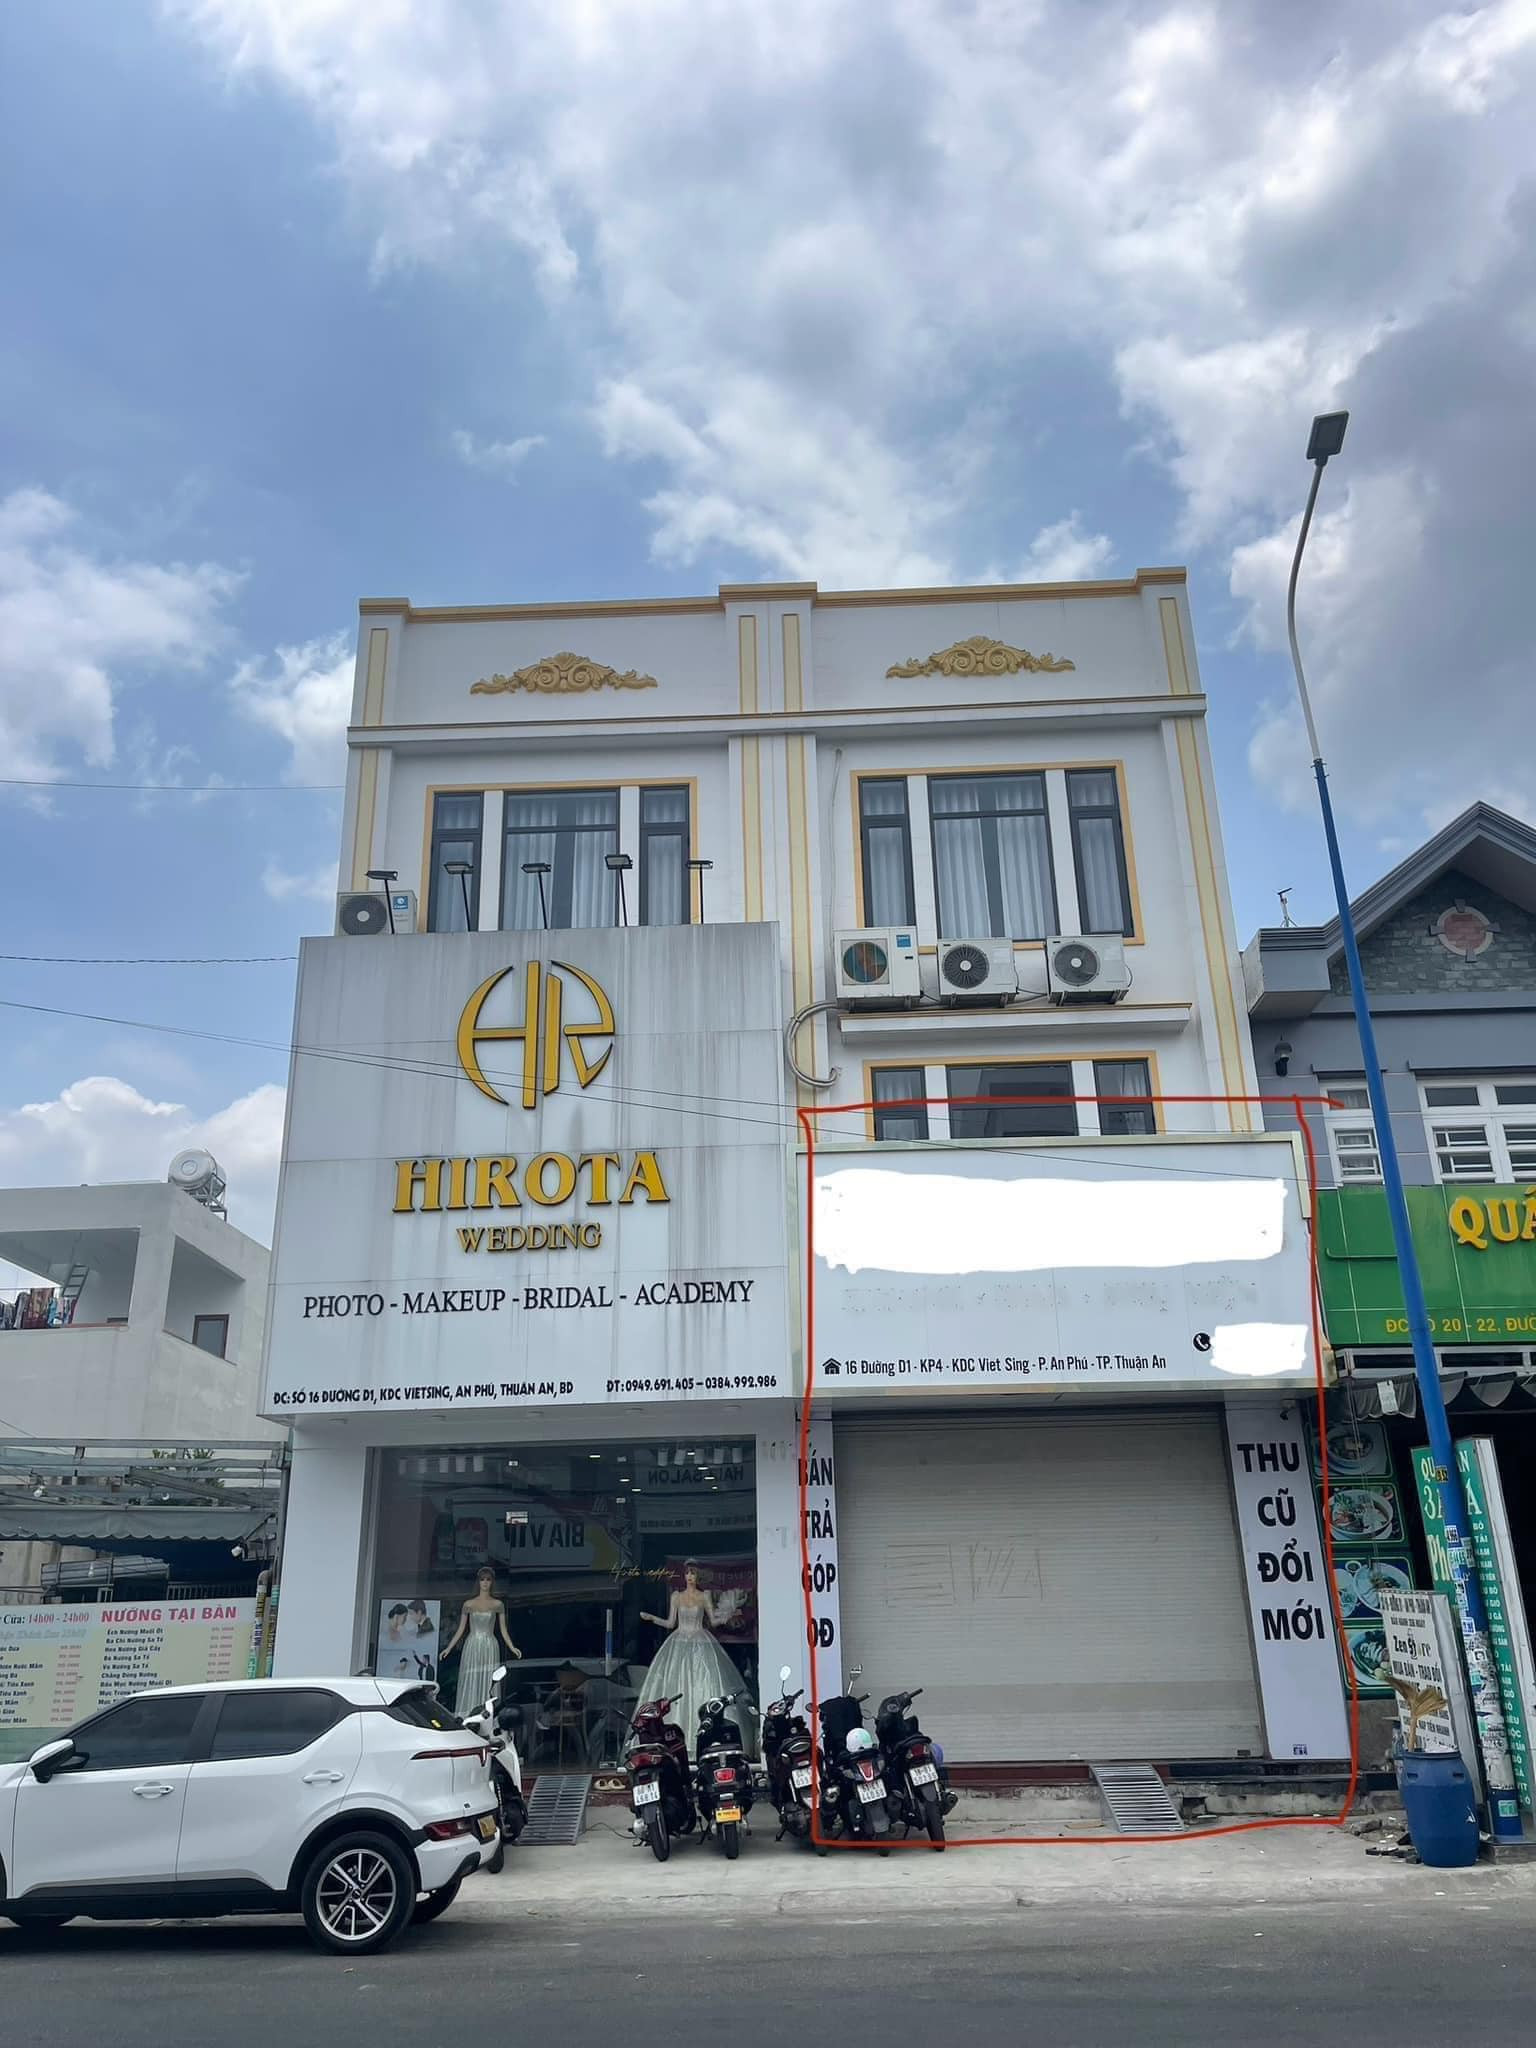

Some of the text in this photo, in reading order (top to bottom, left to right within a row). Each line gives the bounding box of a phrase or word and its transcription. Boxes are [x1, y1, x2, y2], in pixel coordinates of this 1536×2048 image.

[392, 1151, 671, 1212] HIROTA
[456, 1222, 602, 1253] WEDDING
[302, 1293, 384, 1319] PHOTO
[402, 1288, 506, 1315] MAKEUP
[523, 1285, 613, 1311] BRIDAL
[634, 1279, 754, 1307] ACADEMY
[1442, 1318, 1461, 1332] 20
[845, 1360, 857, 1375] 16
[861, 1359, 895, 1377] Đường
[920, 1358, 943, 1373] KP4
[952, 1358, 975, 1373] KDC
[1005, 1357, 1030, 1374] Sing
[1050, 1356, 1065, 1371] An
[1067, 1355, 1088, 1371] Phú
[1114, 1354, 1148, 1372] Thuận
[1152, 1354, 1166, 1369] An
[308, 1390, 319, 1403] 16
[380, 1387, 401, 1401] KDC
[455, 1384, 472, 1399] AN
[1237, 1441, 1300, 1473] THU
[1257, 1488, 1296, 1527] CŨ
[1257, 1538, 1314, 1583] ĐỔI
[101, 1604, 237, 1623] NƯỚNG TẠI BÀN
[1261, 1598, 1325, 1641] MỚI
